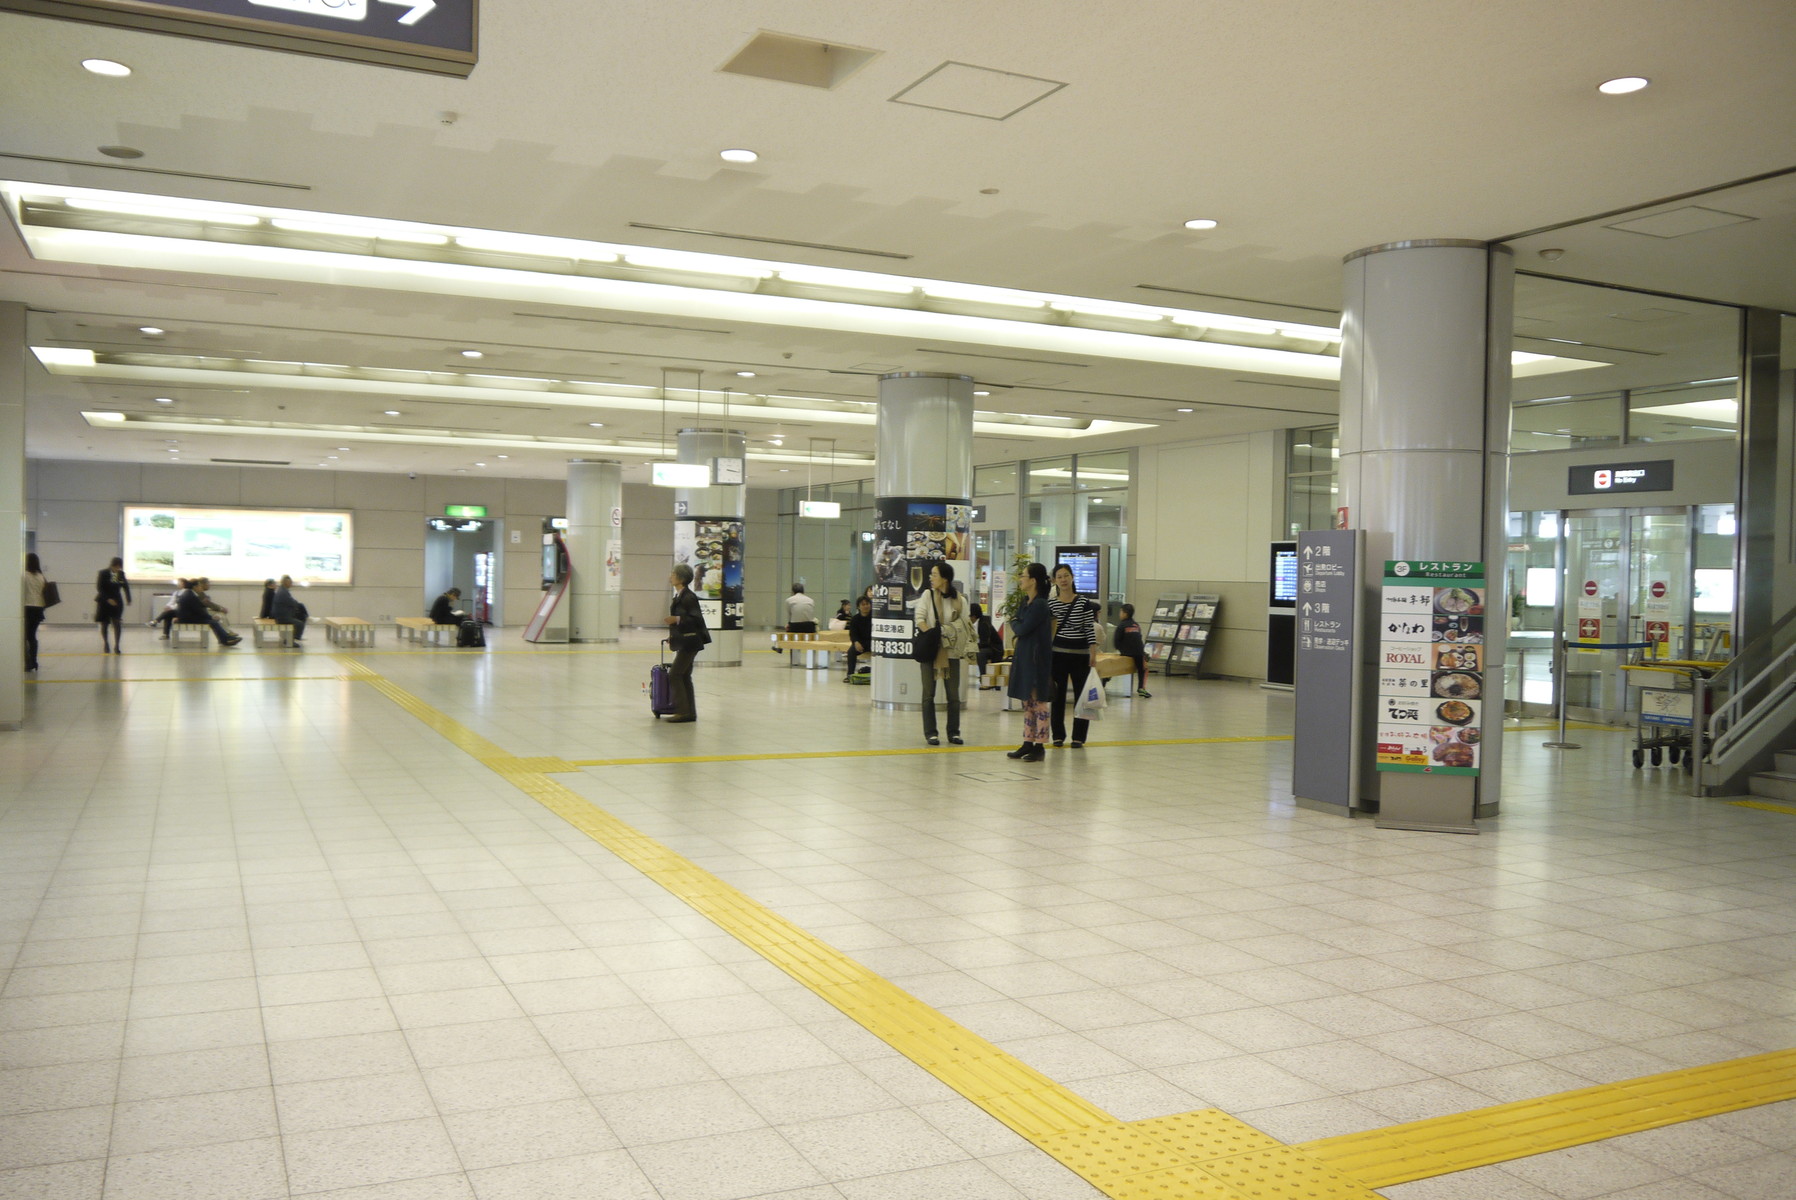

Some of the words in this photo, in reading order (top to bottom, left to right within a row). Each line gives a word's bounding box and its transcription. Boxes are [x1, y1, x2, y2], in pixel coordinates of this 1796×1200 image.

[1315, 545, 1331, 557] 2階
[1396, 565, 1408, 573] 3F
[1419, 562, 1473, 571] レストラン
[1314, 602, 1330, 613] 3階
[1314, 620, 1341, 629] レストラン
[1388, 622, 1425, 634] かなわ
[1386, 653, 1425, 664] ROYAL
